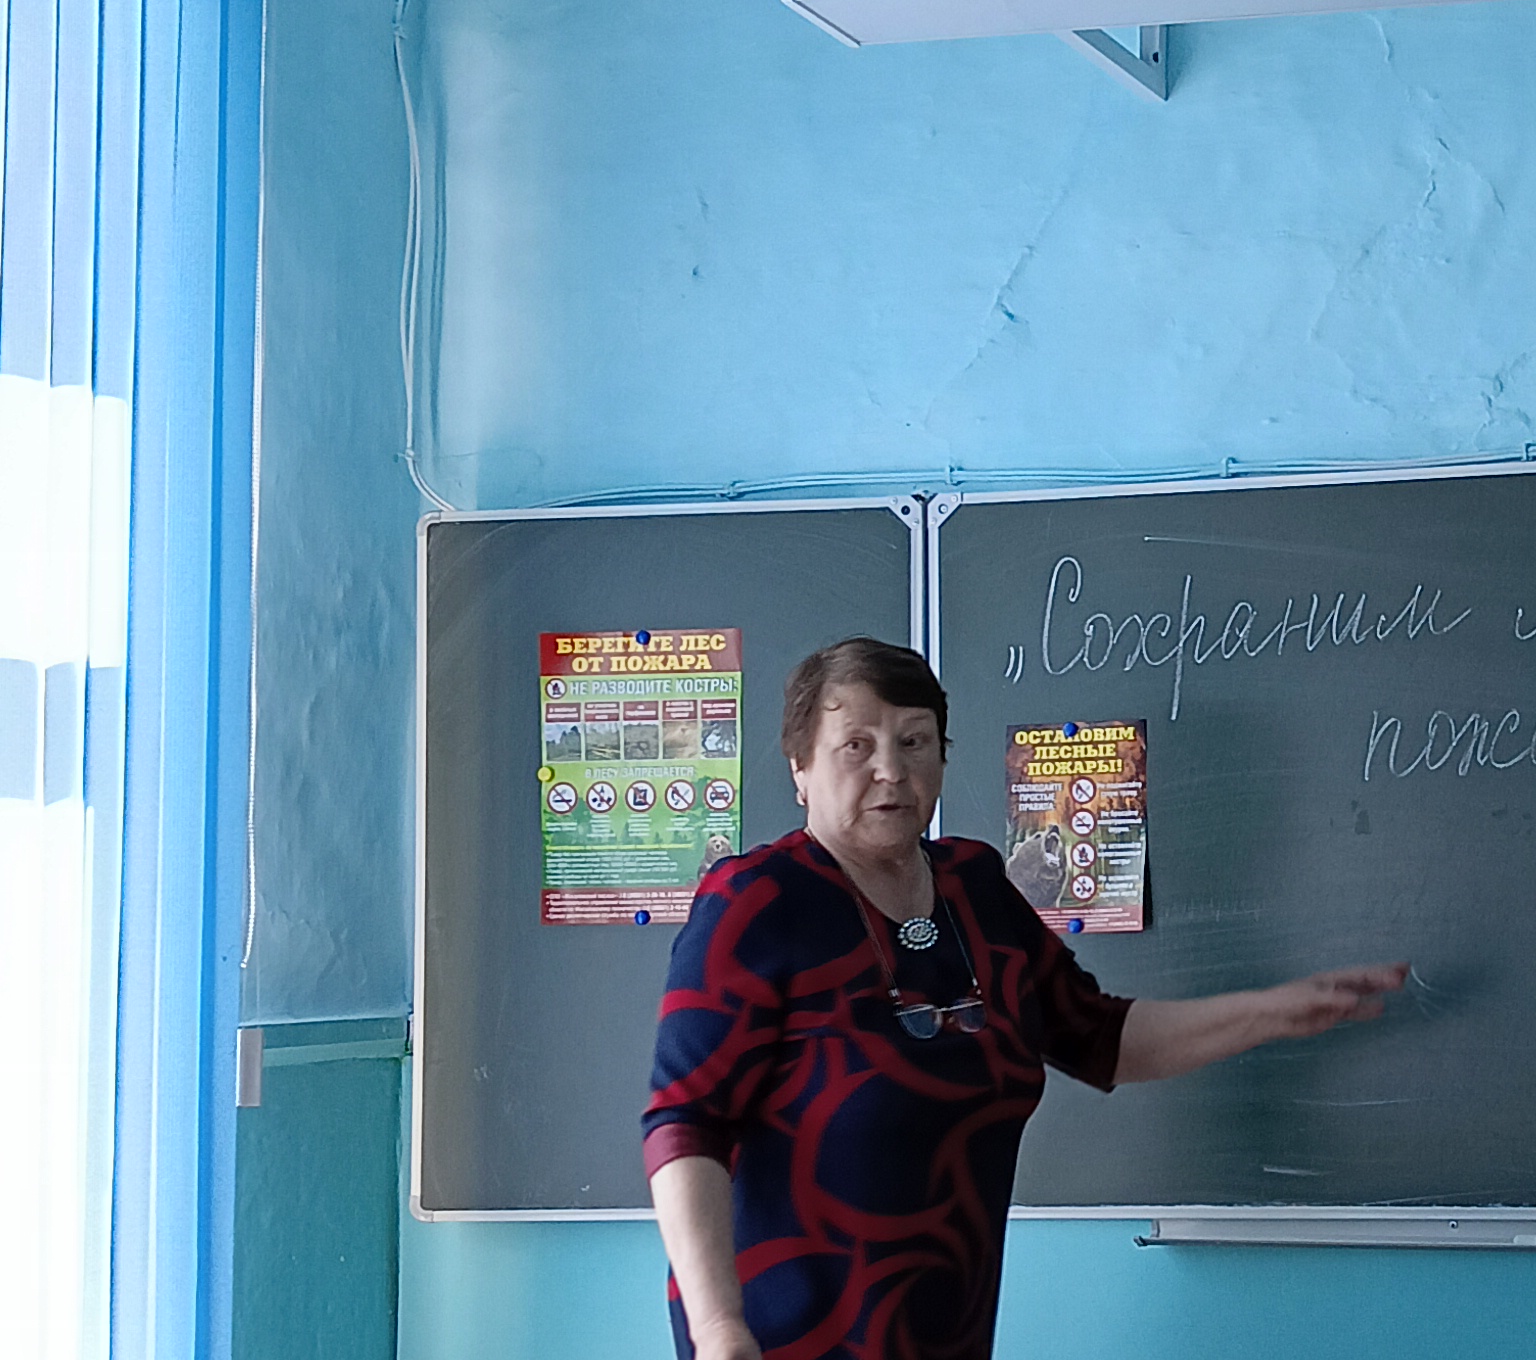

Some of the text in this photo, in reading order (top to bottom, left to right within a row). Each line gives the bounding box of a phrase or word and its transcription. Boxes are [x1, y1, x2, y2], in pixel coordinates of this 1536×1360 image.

[679, 634, 726, 651] ЛЕС
[572, 654, 712, 673] ОТ ПОЖАРА
[569, 678, 737, 696] НЕ РАЗВОДИТЕ КОСТРЫ:
[1015, 726, 1135, 745] ОСТАОВИМ
[1034, 744, 1116, 760] ЛЕСНЫЕ
[593, 767, 618, 779] ЛЕСУ
[1027, 759, 1123, 776] ПОЖАРЫ!
